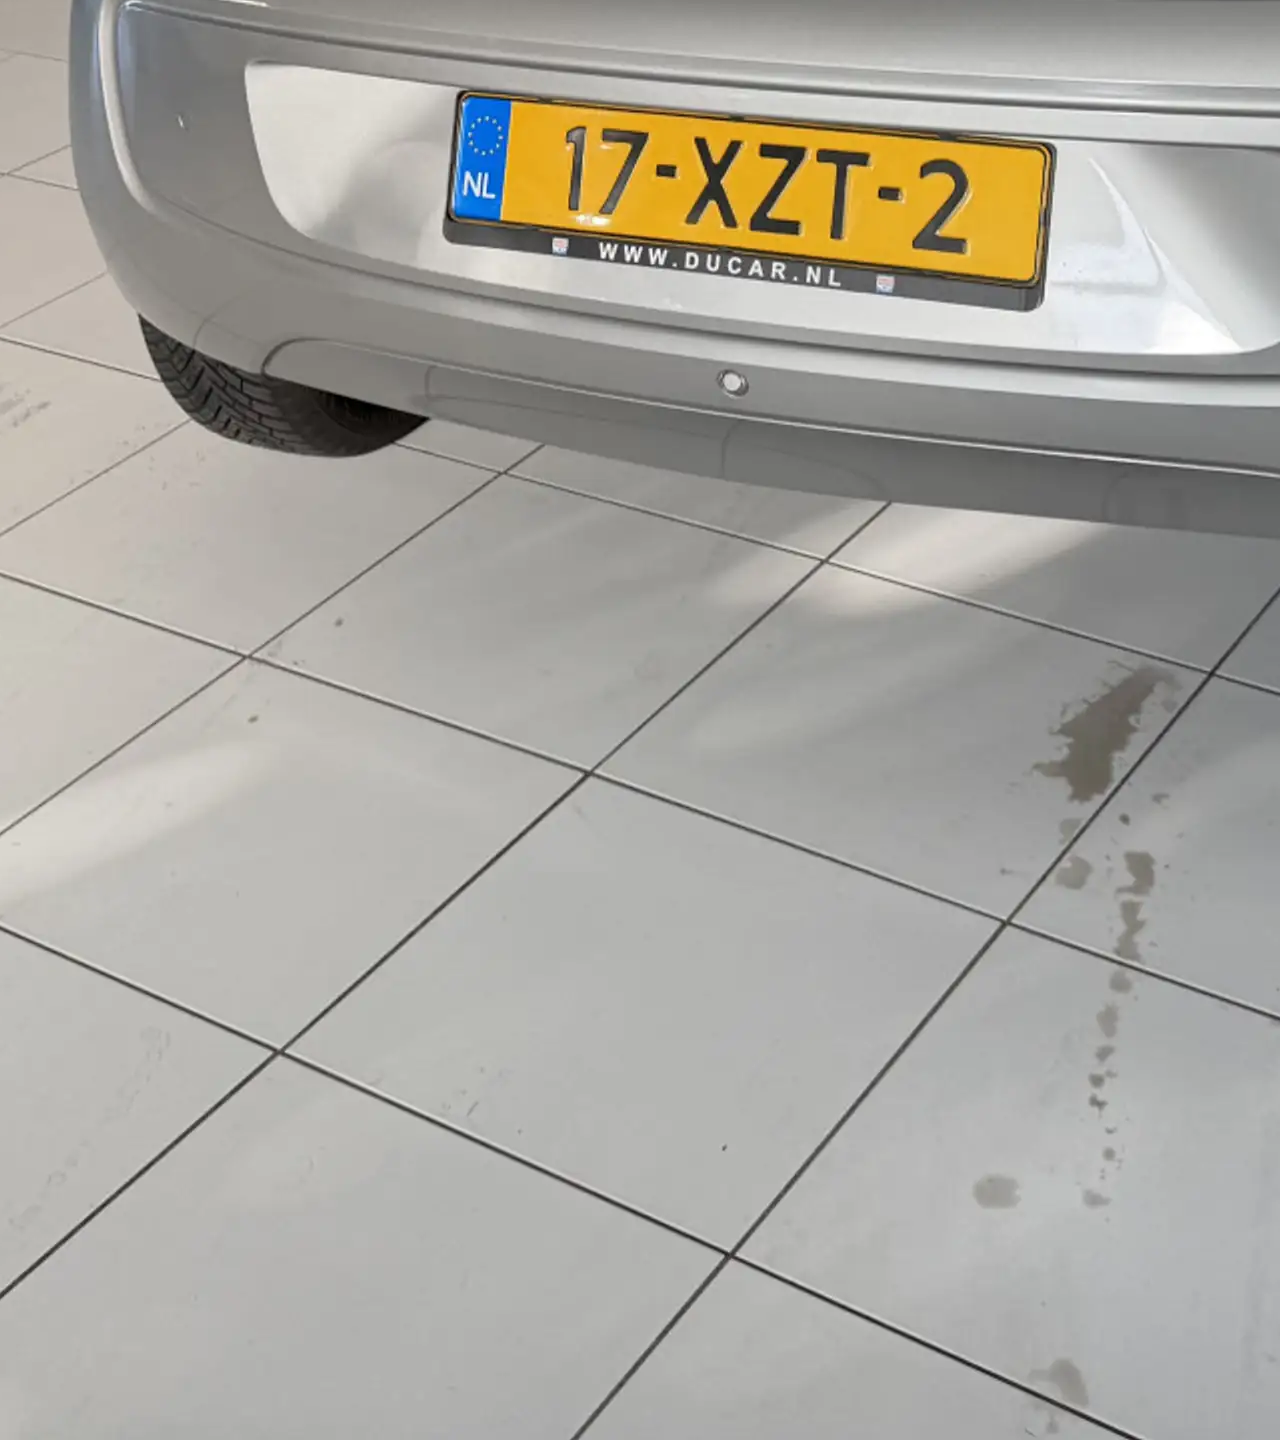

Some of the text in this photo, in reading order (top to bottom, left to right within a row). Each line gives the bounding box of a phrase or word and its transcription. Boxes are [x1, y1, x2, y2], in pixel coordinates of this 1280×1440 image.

[463, 170, 496, 199] NL
[565, 125, 970, 254] 17-XZT-2
[598, 242, 841, 287] WWW.DUCAR.NL
